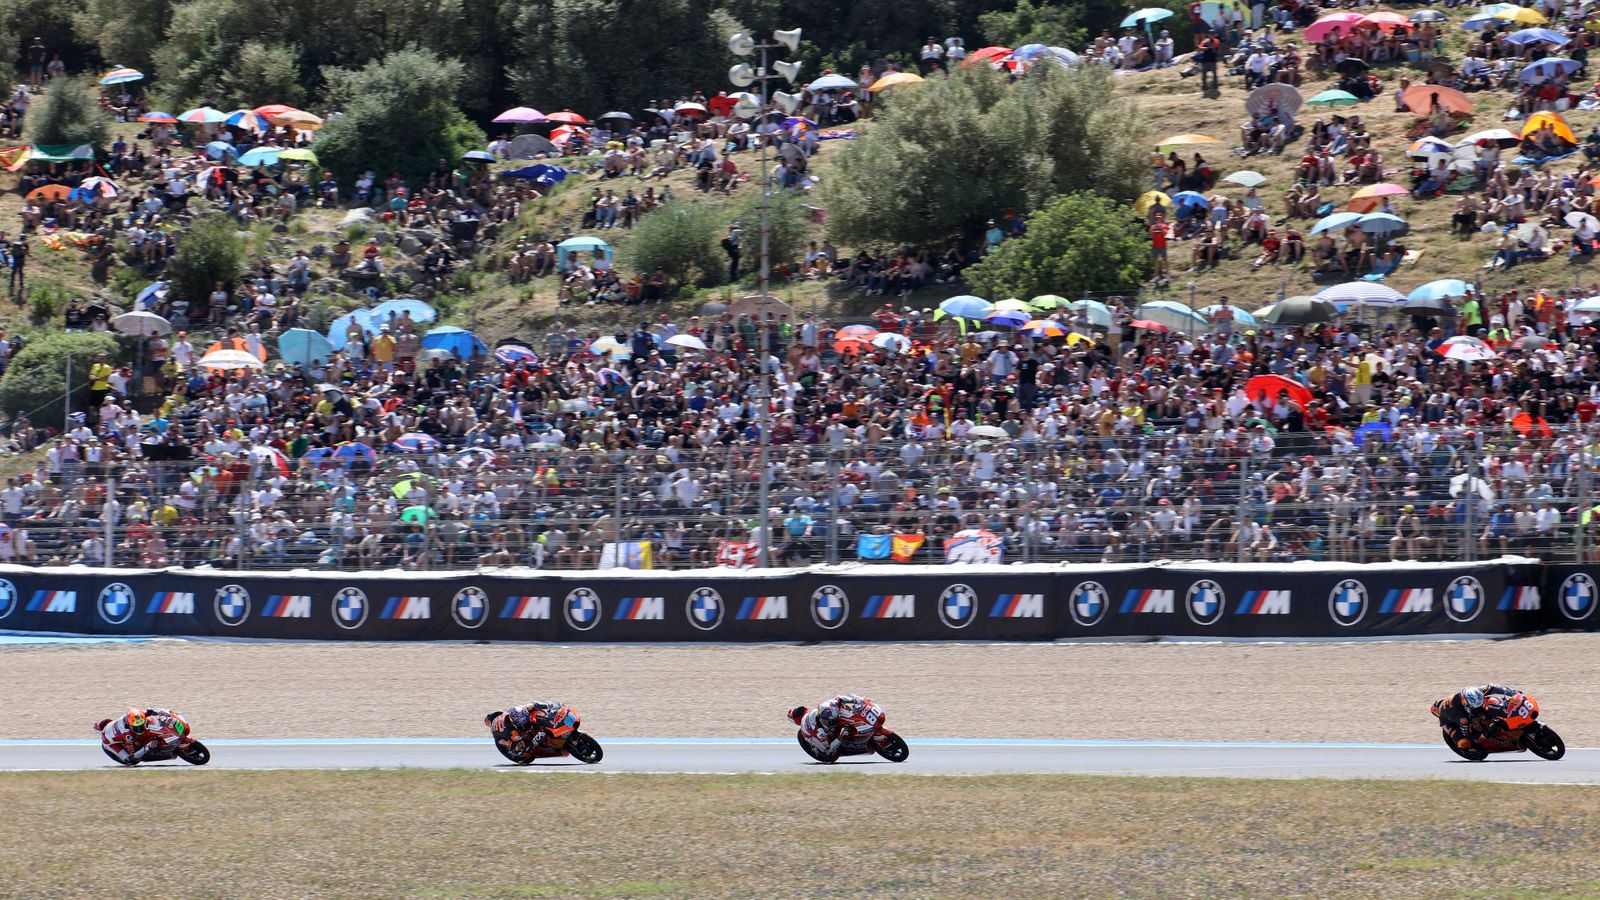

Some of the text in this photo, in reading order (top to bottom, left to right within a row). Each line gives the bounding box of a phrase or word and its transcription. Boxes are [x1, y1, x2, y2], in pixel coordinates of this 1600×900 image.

[165, 593, 193, 613] M
[282, 596, 310, 617] M
[401, 597, 429, 619] M
[520, 597, 549, 619] M
[635, 598, 663, 619] M
[757, 596, 786, 619] M
[884, 595, 914, 617] M
[1012, 594, 1043, 617] M
[1142, 590, 1173, 613] M
[1258, 591, 1290, 614] M
[1402, 589, 1432, 612] M
[1518, 700, 1534, 720] 96
